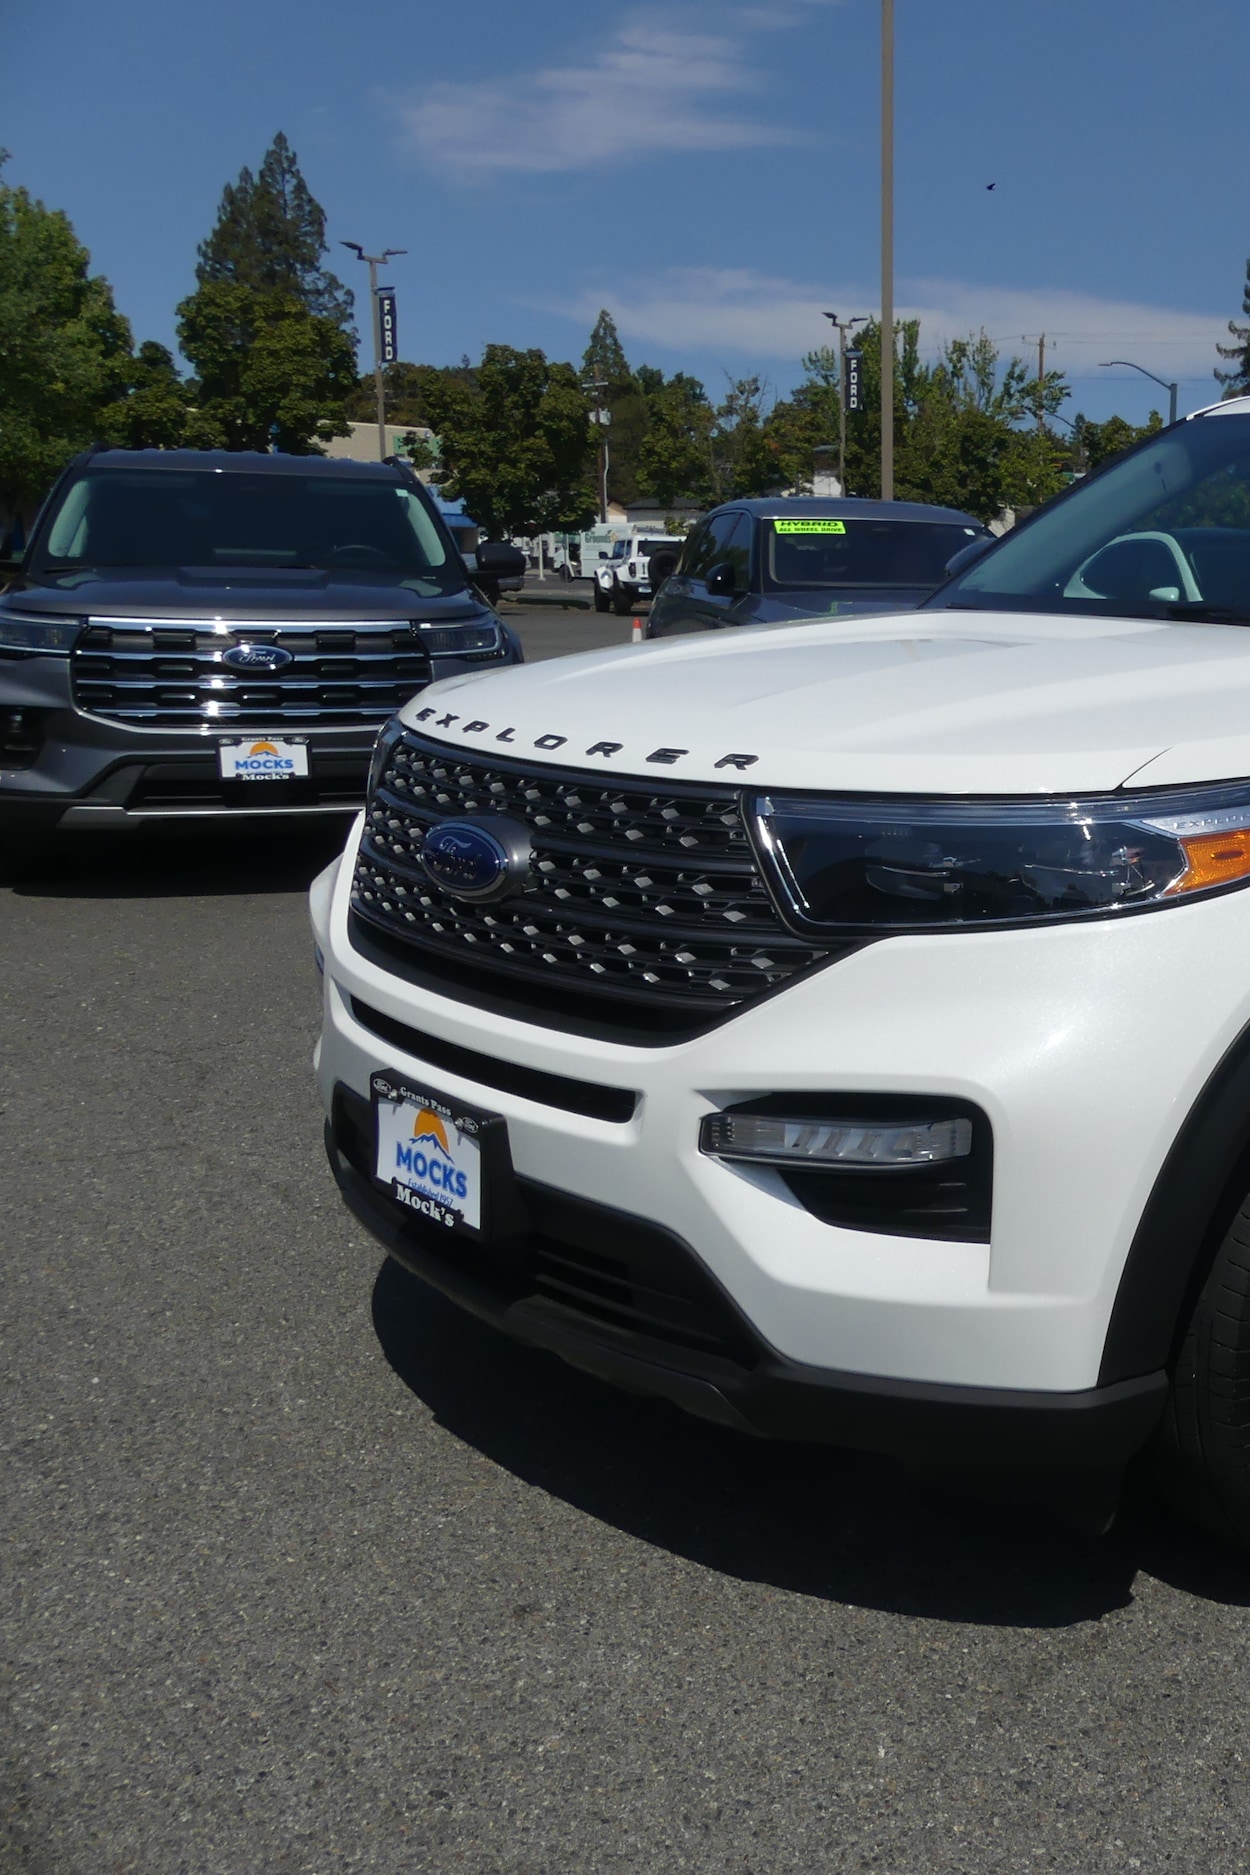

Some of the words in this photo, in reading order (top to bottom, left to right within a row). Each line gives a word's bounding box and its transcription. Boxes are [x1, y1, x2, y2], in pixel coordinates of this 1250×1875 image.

[383, 299, 394, 360] FORD
[850, 359, 858, 409] FORD
[239, 649, 277, 664] Ford
[415, 707, 760, 771] EXPLORER
[234, 759, 294, 770] MOCKS
[427, 834, 482, 882] Ford
[400, 1086, 430, 1107] Grants
[430, 1099, 452, 1117] Pass
[395, 1141, 468, 1199] MOCKS
[407, 1178, 440, 1201] Established
[395, 1183, 455, 1228] Mock's
